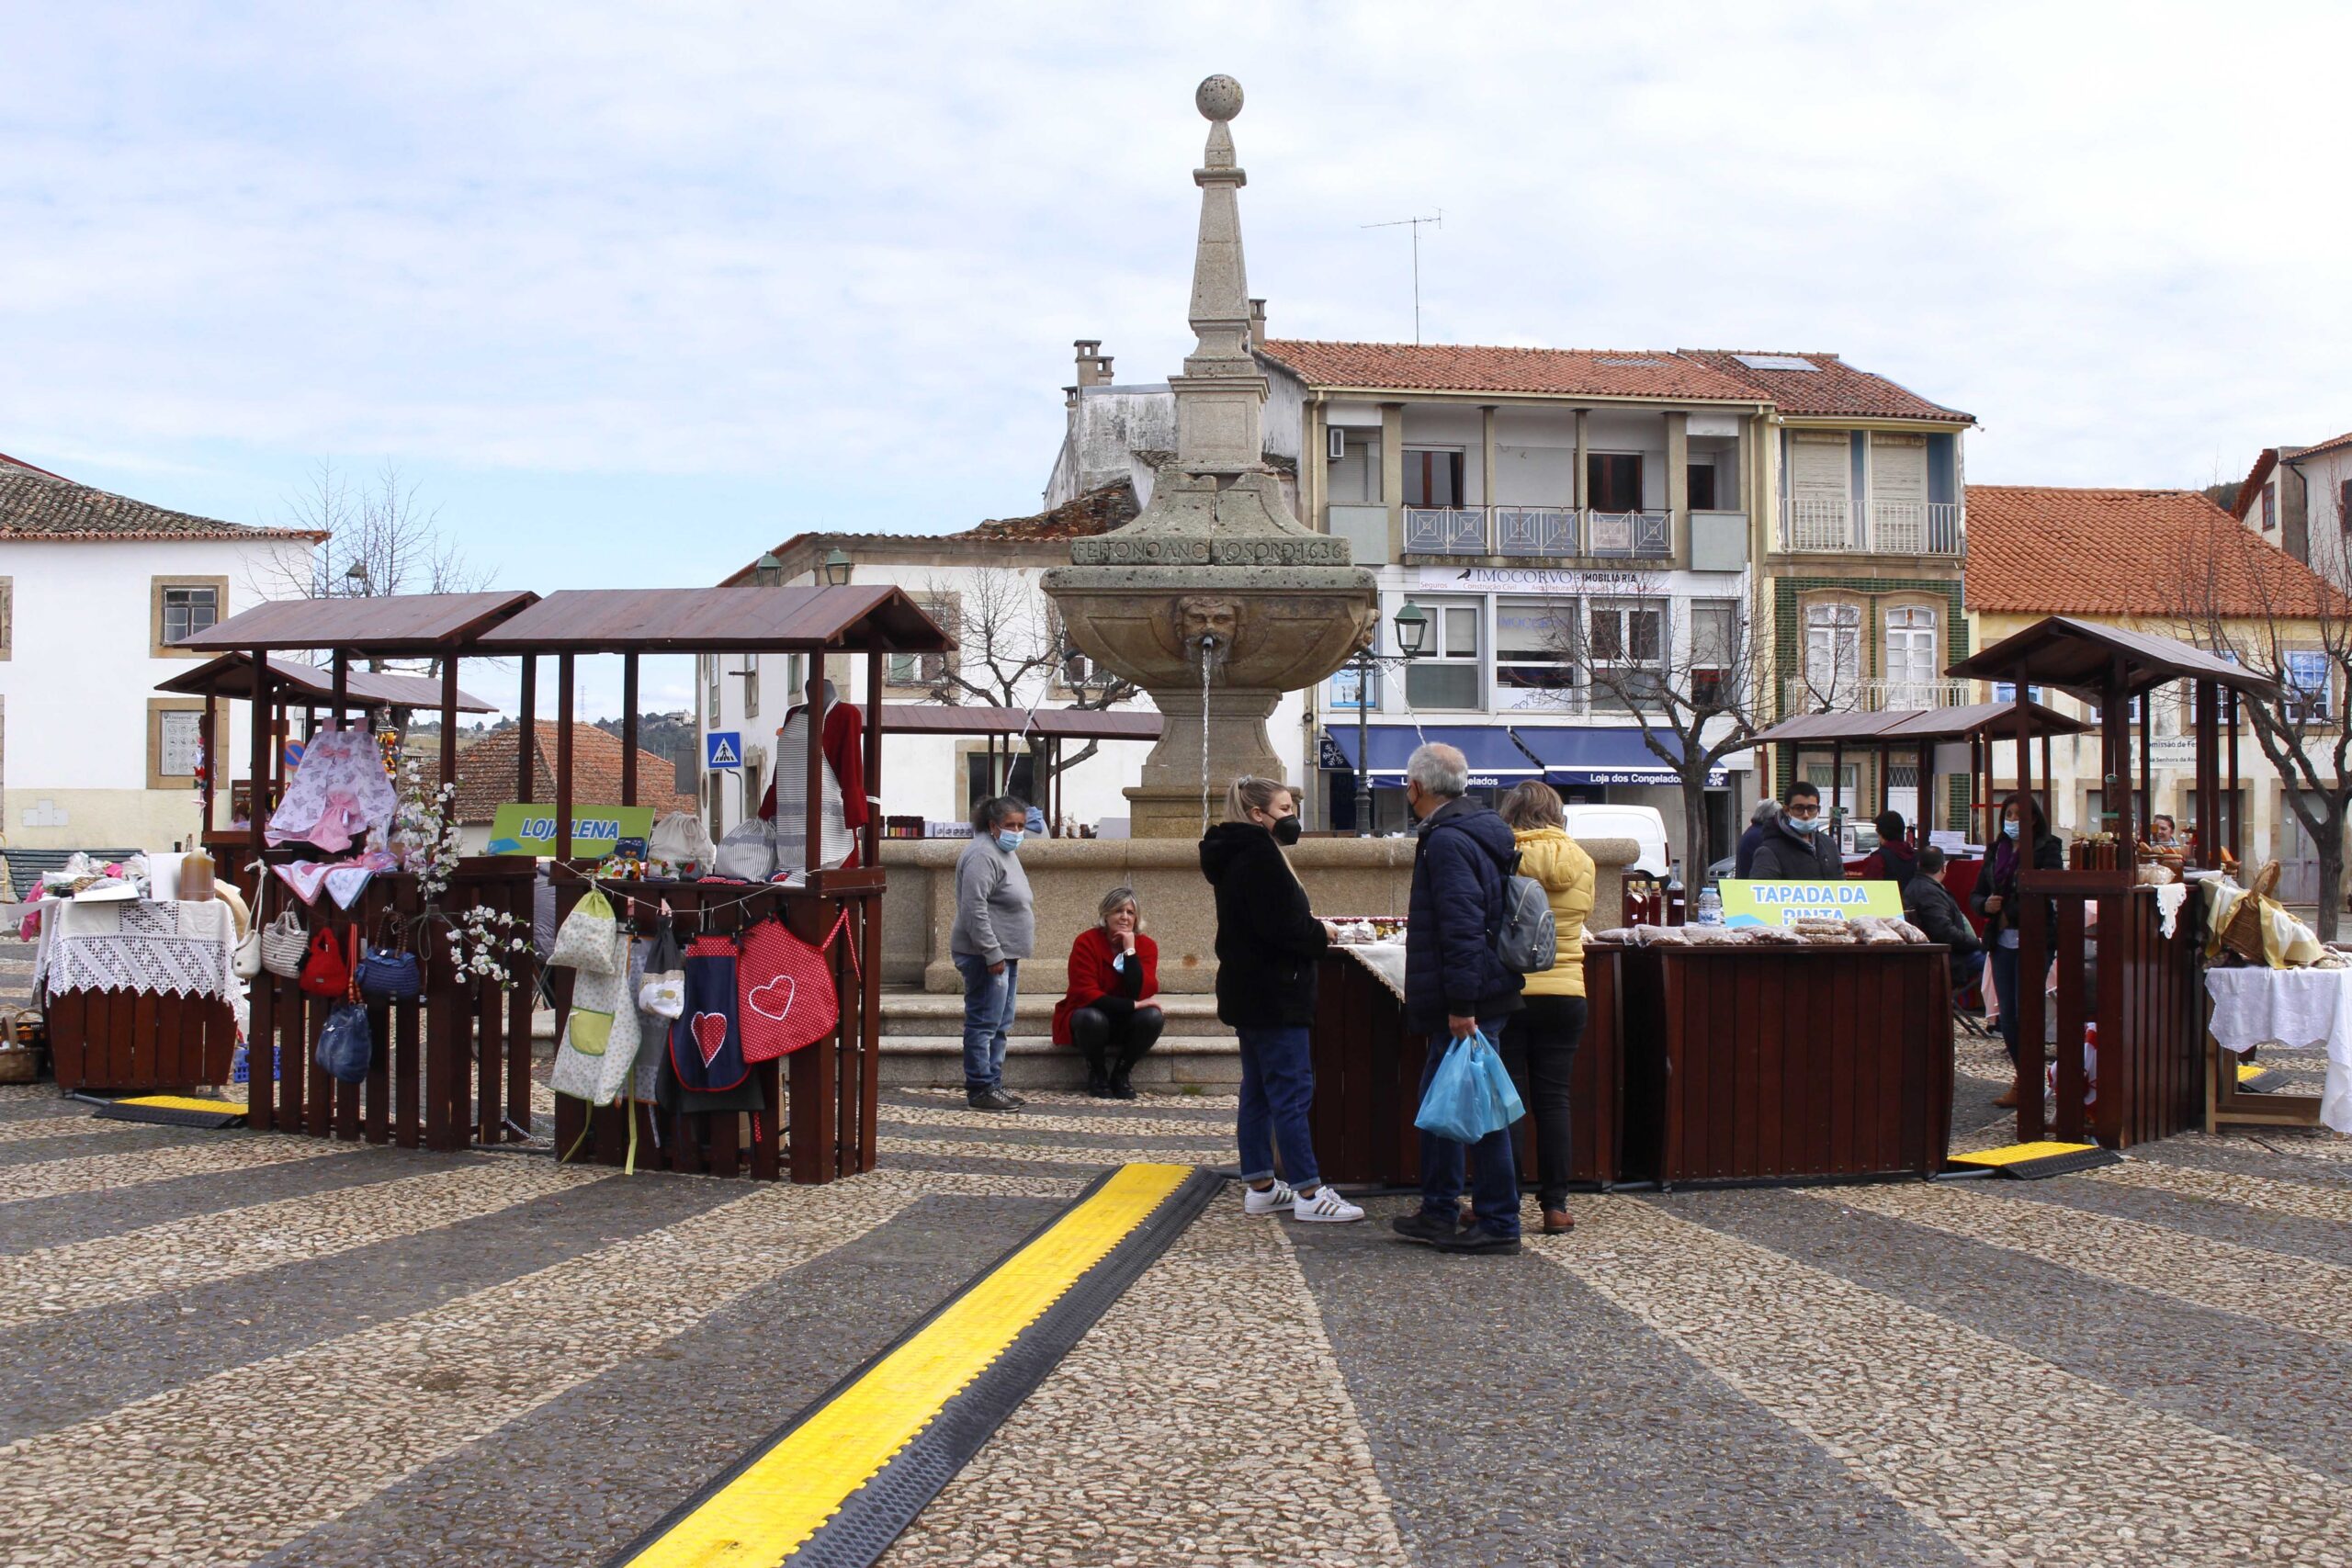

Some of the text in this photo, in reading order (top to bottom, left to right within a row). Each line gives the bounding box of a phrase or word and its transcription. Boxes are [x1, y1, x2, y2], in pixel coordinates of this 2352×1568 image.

[1476, 569, 1573, 583] IMOCORVO
[1420, 581, 1448, 590] Seguros
[1463, 582, 1501, 592] Construção
[1590, 773, 1609, 784] Loja
[1611, 773, 1629, 783] dos
[1751, 886, 1869, 904] TAPADA DA
